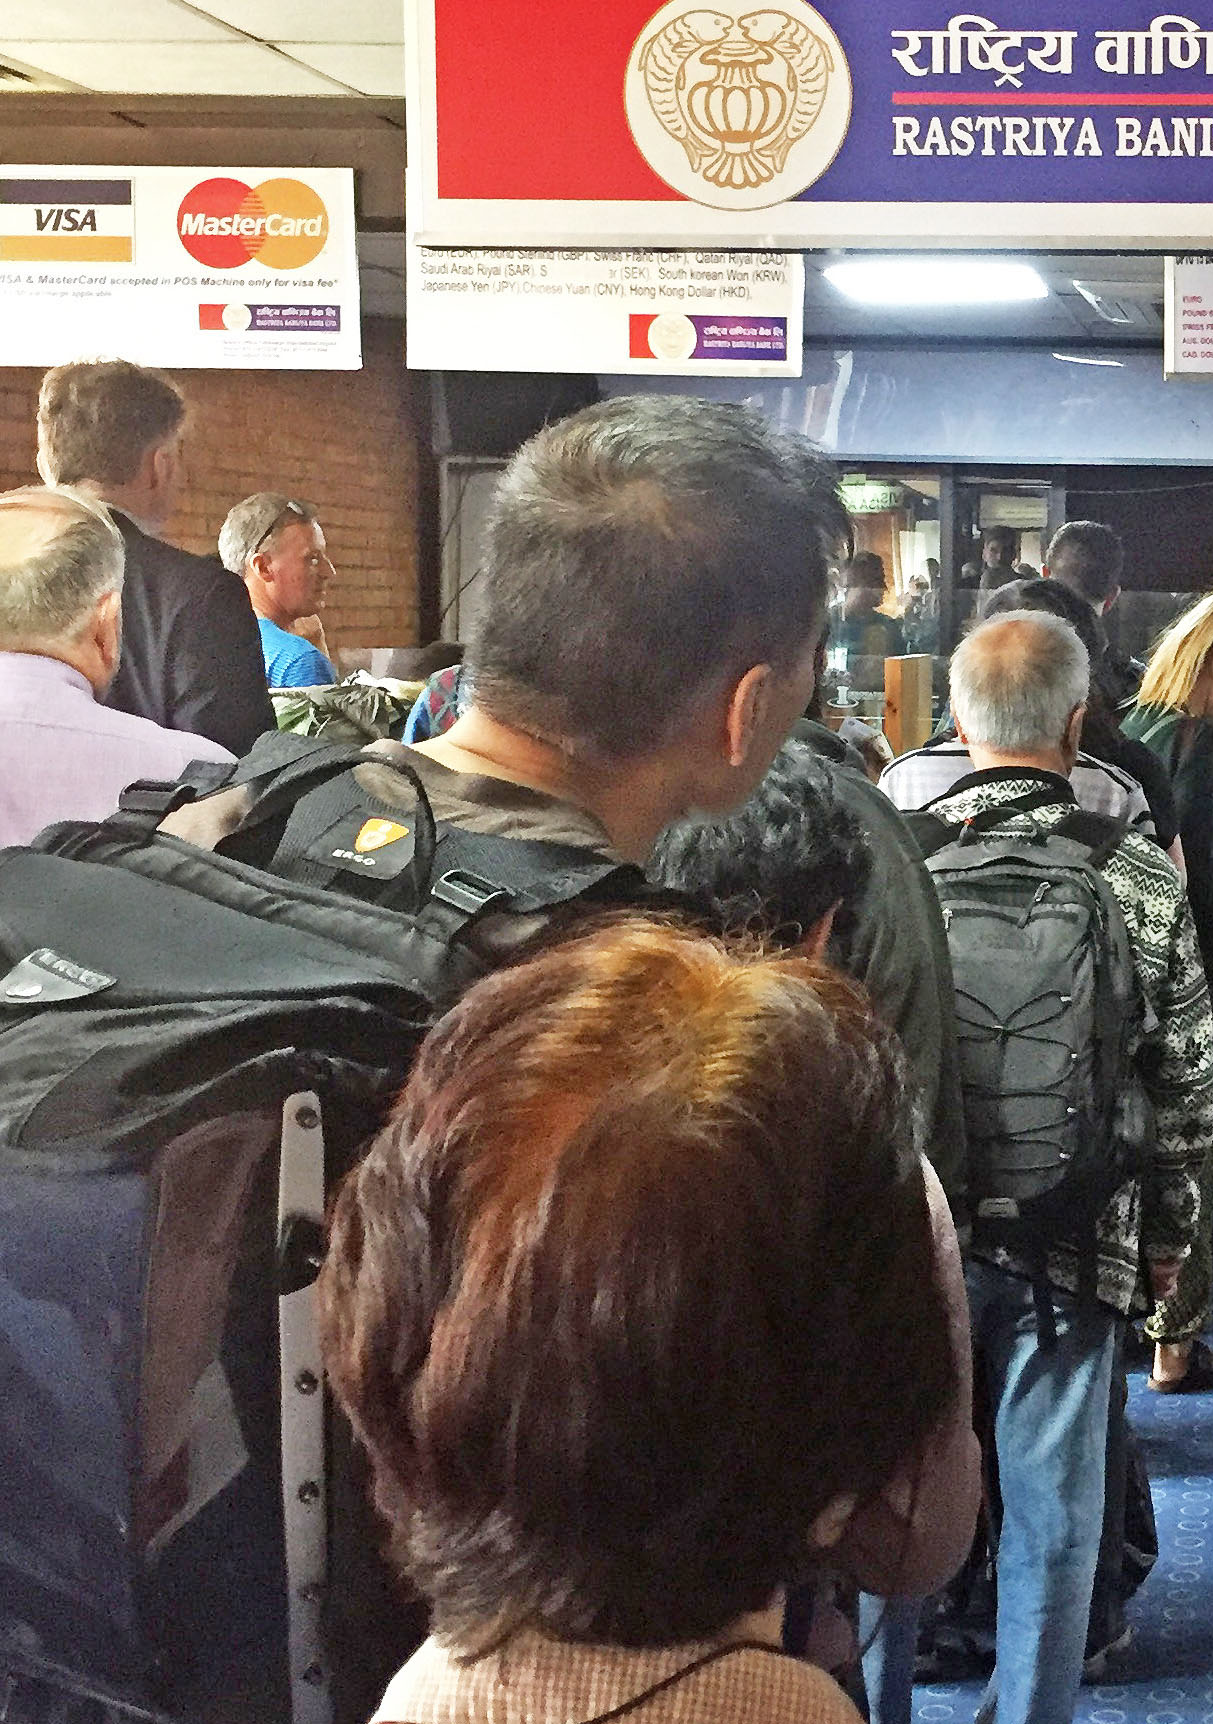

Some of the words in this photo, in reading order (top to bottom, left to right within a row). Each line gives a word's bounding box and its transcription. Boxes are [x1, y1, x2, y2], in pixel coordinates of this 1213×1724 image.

[891, 15, 1078, 88] राष्ट्रिय
[891, 117, 1102, 157] RASTRIYA
[34, 208, 97, 232] VISA
[180, 213, 322, 237] MasterCard
[420, 262, 448, 275] Saudi
[451, 263, 474, 275] Arab
[477, 263, 501, 278] Riyal
[658, 268, 687, 280] South
[727, 270, 749, 281] Won
[26, 276, 34, 284] &
[38, 275, 107, 285] MasterCard
[110, 276, 159, 286] accepted
[161, 276, 171, 285] in
[173, 276, 198, 286] POS
[201, 277, 245, 286] Machine
[248, 278, 272, 288] only
[274, 278, 289, 287] for
[293, 278, 314, 287] visa
[421, 280, 468, 293] Japanese
[471, 281, 489, 292] Yen
[566, 283, 590, 295] Yuan
[630, 285, 655, 299] Hong
[659, 286, 685, 300] Kong
[688, 286, 716, 298] Dollar
